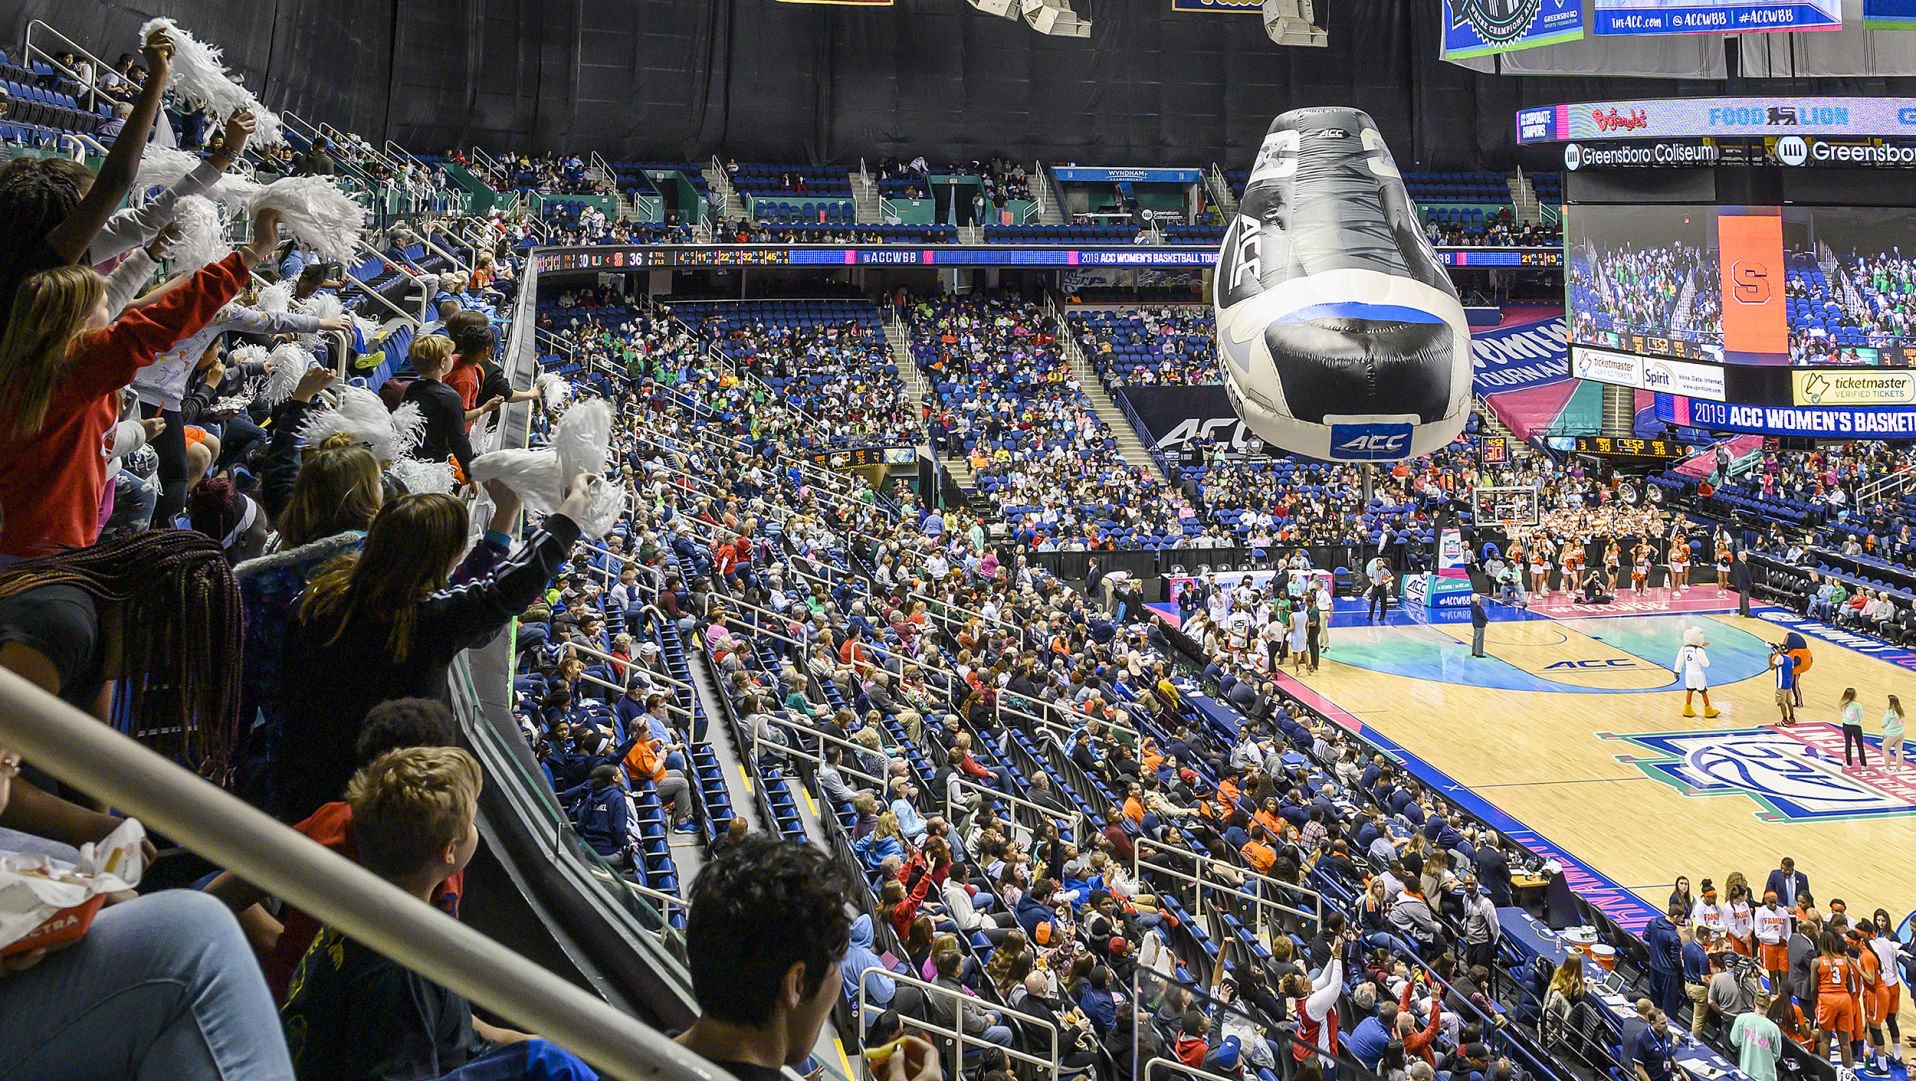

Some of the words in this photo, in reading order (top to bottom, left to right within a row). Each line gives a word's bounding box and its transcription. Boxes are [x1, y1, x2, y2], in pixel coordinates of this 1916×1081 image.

[1738, 8, 1793, 24] #ACCWBB
[1489, 15, 1525, 35] CHAMPIONS
[1709, 107, 1765, 126] FOOD
[1800, 107, 1849, 125] LION
[1318, 129, 1344, 138] ACC
[1582, 147, 1651, 165] Greensboro
[1654, 143, 1714, 162] Coliseum
[864, 252, 916, 263] @ACCWBB
[1234, 213, 1262, 288] ACC
[629, 252, 643, 266] 36
[1081, 253, 1099, 263] 2019
[1100, 253, 1116, 263] ACC
[1116, 253, 1152, 263] WOMEN'S
[1153, 253, 1199, 263] BASKETBALL
[1521, 255, 1532, 263] 21
[1546, 255, 1556, 263] 13
[1731, 260, 1771, 304] S
[1594, 356, 1634, 372] ticketmaster
[1645, 368, 1670, 386] Spirit
[1835, 378, 1907, 390] ticketmaster
[1873, 390, 1905, 398] TICKETS
[1695, 402, 1726, 424] 2019
[1730, 406, 1764, 426] ACC
[1765, 408, 1851, 431] WOMEN'S
[1340, 433, 1408, 450] ACC
[1599, 443, 1611, 452] 30
[1623, 439, 1644, 449] 4:52
[1487, 447, 1503, 462] 30
[1654, 447, 1666, 456] 36
[1407, 580, 1428, 594] ACC
[1543, 658, 1636, 669] ACC
[1763, 917, 1785, 926] FAMILY
[1831, 967, 1841, 984] 3
